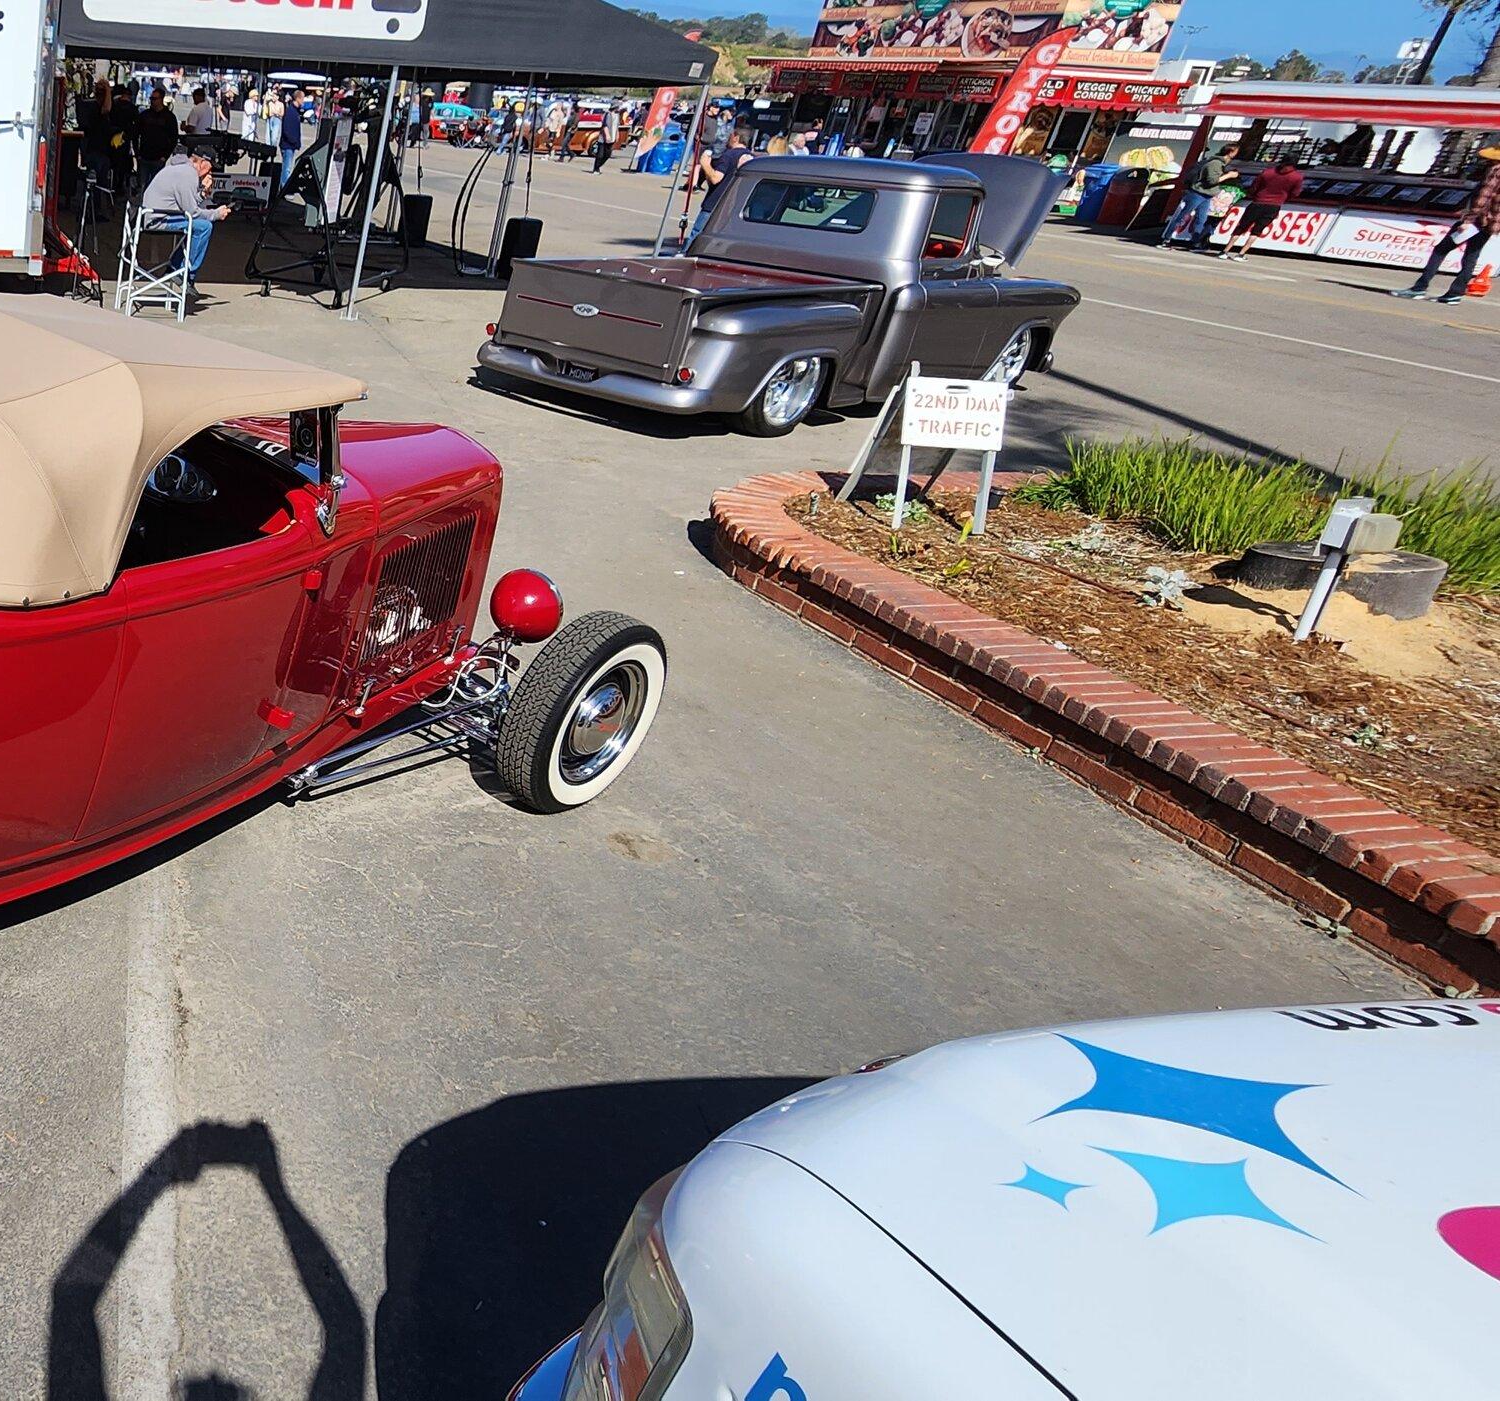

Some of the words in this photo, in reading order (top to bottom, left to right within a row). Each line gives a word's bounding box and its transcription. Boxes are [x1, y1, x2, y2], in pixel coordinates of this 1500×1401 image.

[1077, 81, 1117, 92] VEGGIE
[1125, 85, 1168, 95] CHICKEN
[1074, 91, 1113, 100] COMBO
[1132, 94, 1152, 103] PITA
[1326, 246, 1423, 265] AUTHORIZED
[914, 394, 959, 409] 22ND
[966, 397, 1001, 412] DAA
[918, 419, 991, 437] TRAFFIC
